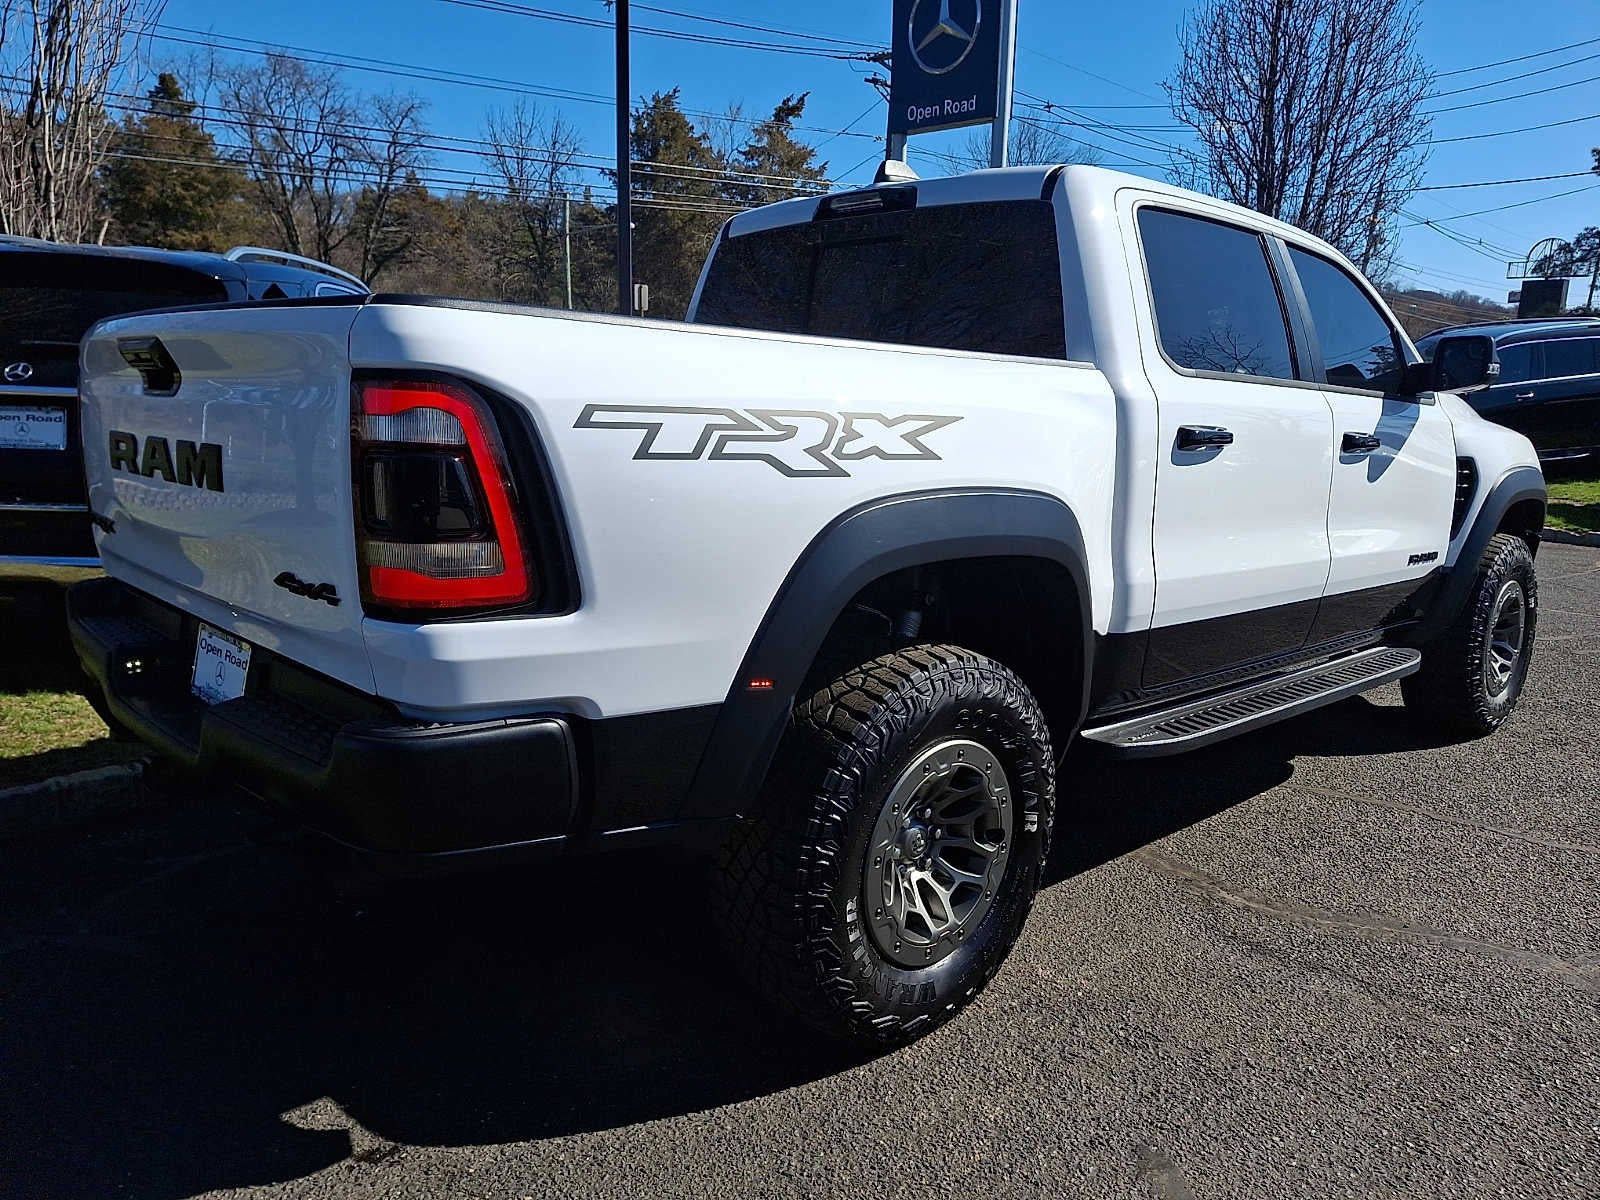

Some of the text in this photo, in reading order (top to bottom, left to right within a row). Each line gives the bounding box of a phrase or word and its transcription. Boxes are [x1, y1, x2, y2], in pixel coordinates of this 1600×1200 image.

[907, 95, 976, 123] Open Road
[26, 414, 62, 423] Road
[572, 403, 965, 478] TRX
[108, 430, 224, 493] RAM
[200, 638, 222, 657] Open
[225, 650, 248, 670] Road
